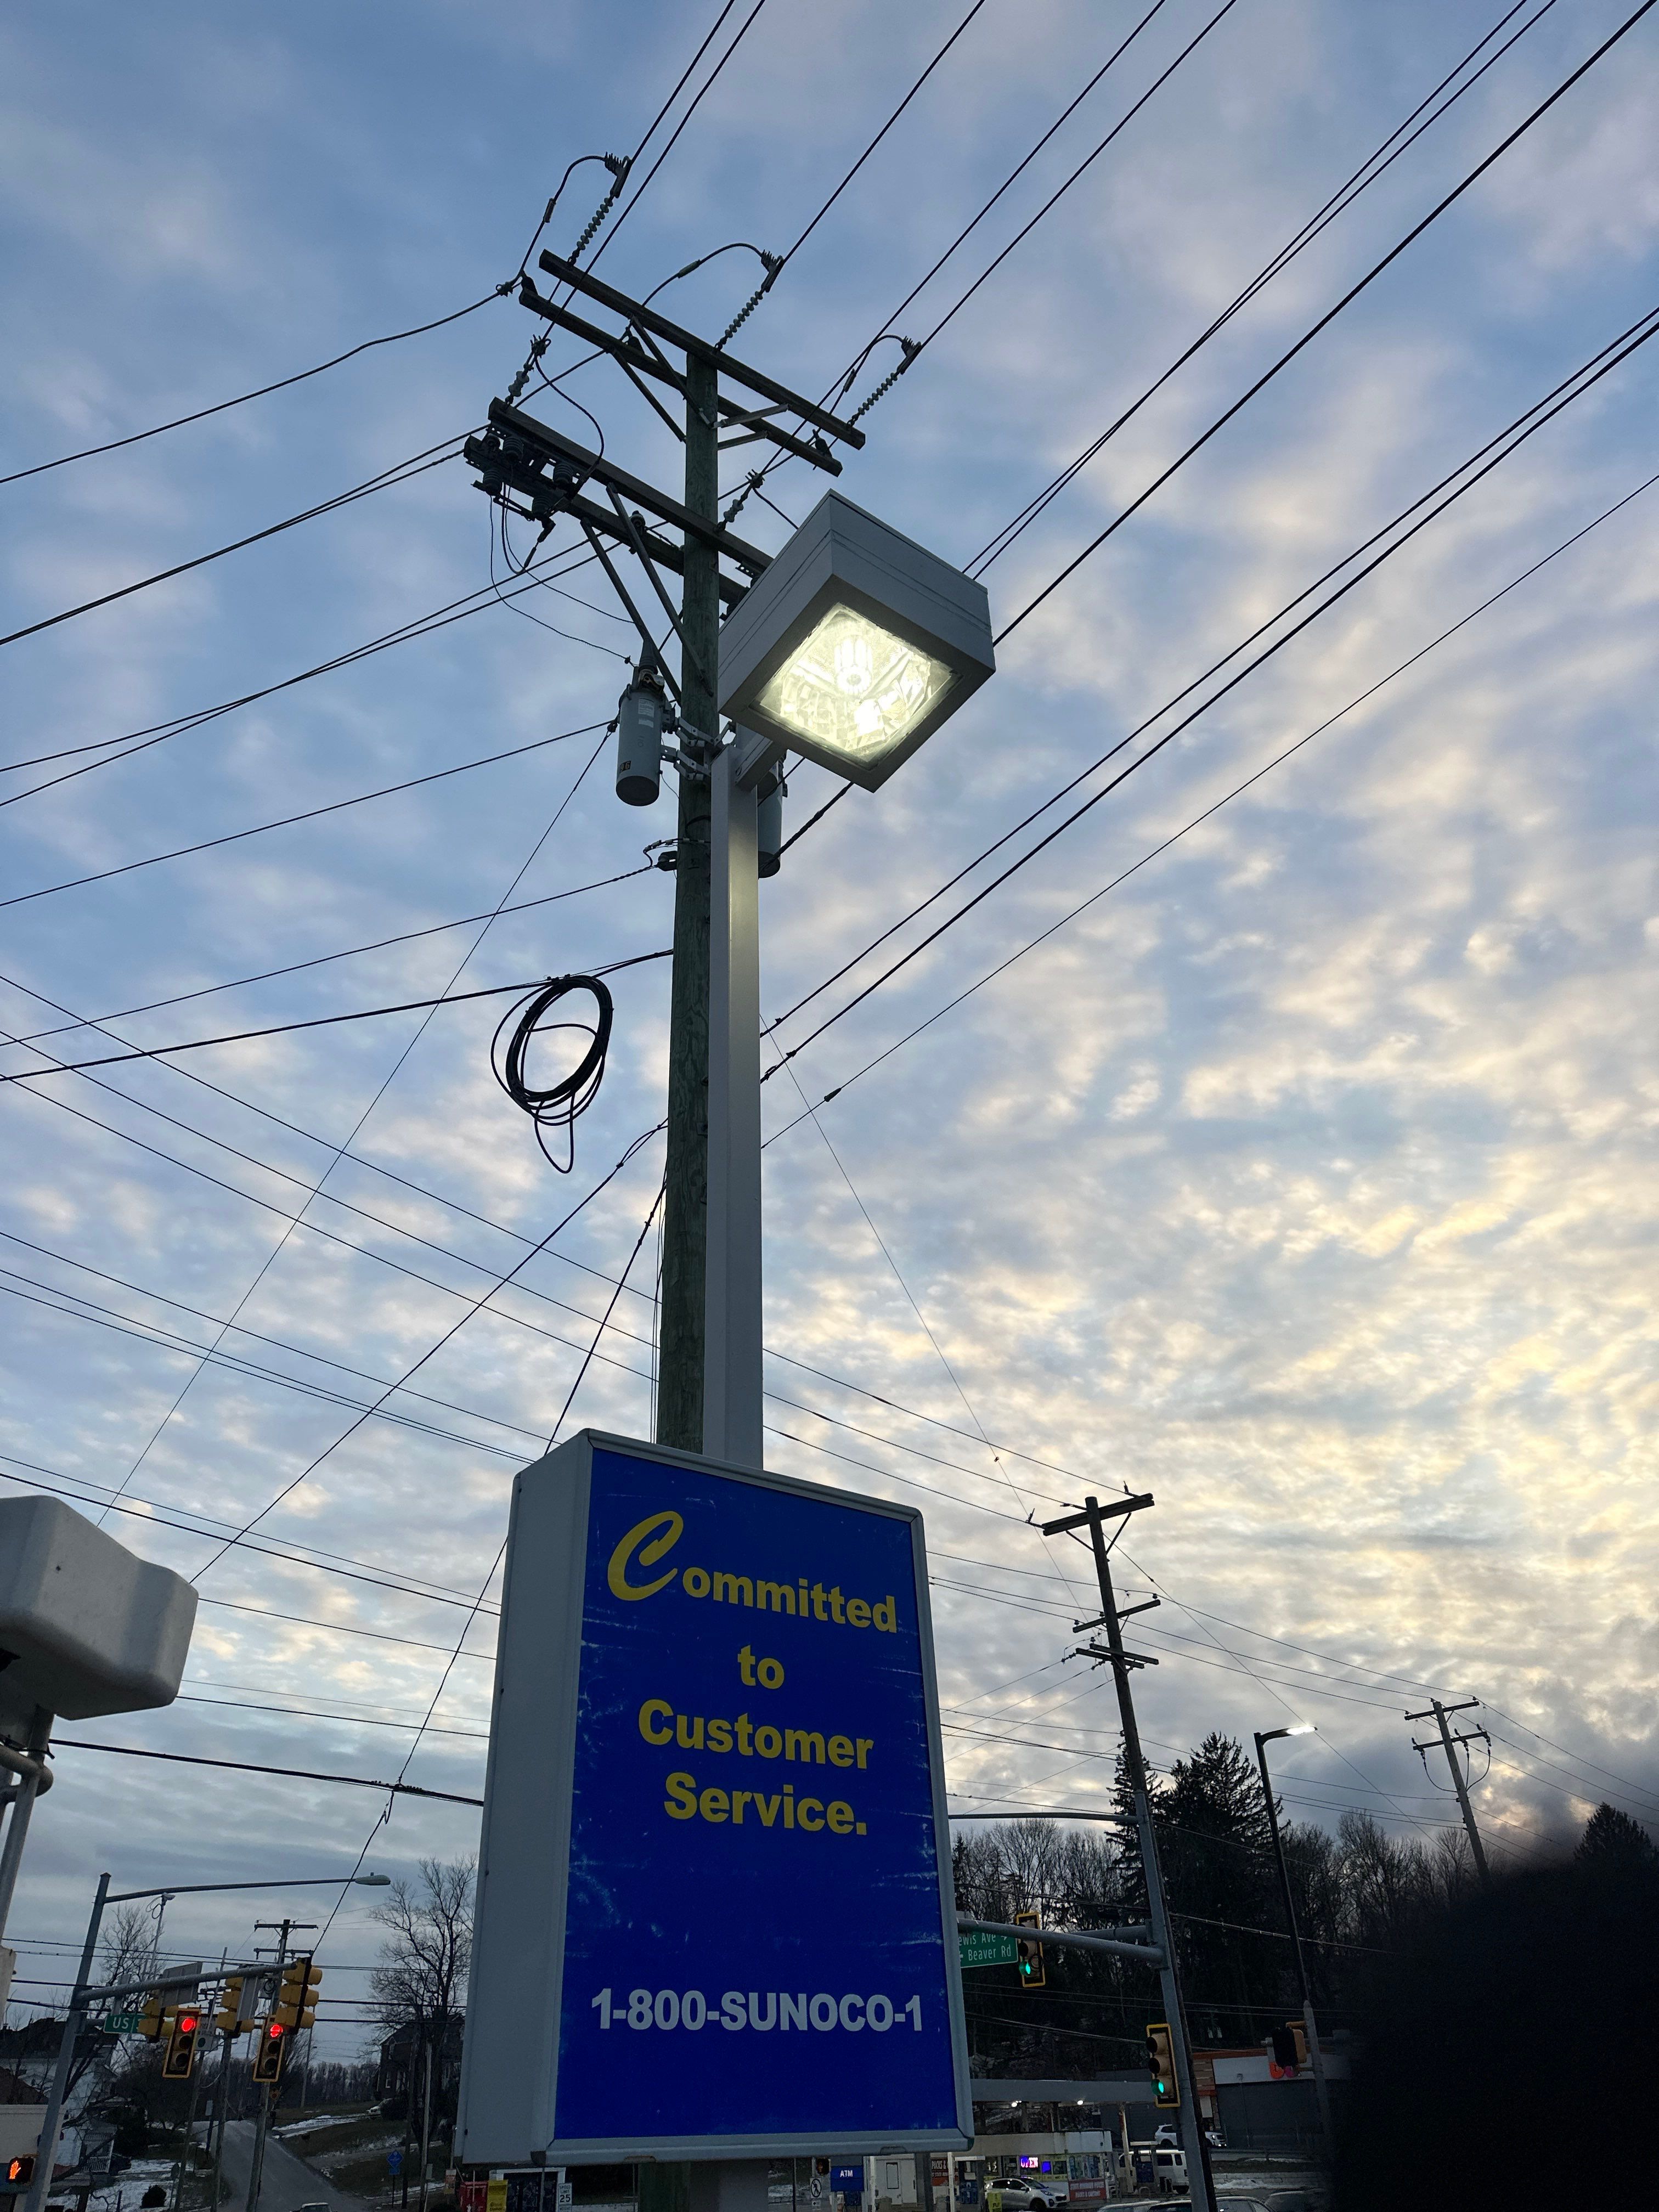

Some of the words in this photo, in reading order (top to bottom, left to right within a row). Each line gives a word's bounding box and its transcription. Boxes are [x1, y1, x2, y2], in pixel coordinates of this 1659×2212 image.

[607, 1511, 897, 1633] Committed
[737, 1645, 784, 1689] to
[639, 1699, 874, 1769] Customer
[664, 1772, 867, 1836] Service.
[958, 1934, 977, 1946] ewis
[981, 1932, 996, 1944] Ave
[968, 1949, 996, 1961] Beaver
[1001, 1944, 1011, 1957] Rd
[112, 2017, 130, 2029] US
[591, 1988, 923, 2032] 1-800-SUNOCO-1
[560, 2194, 571, 2203] 25
